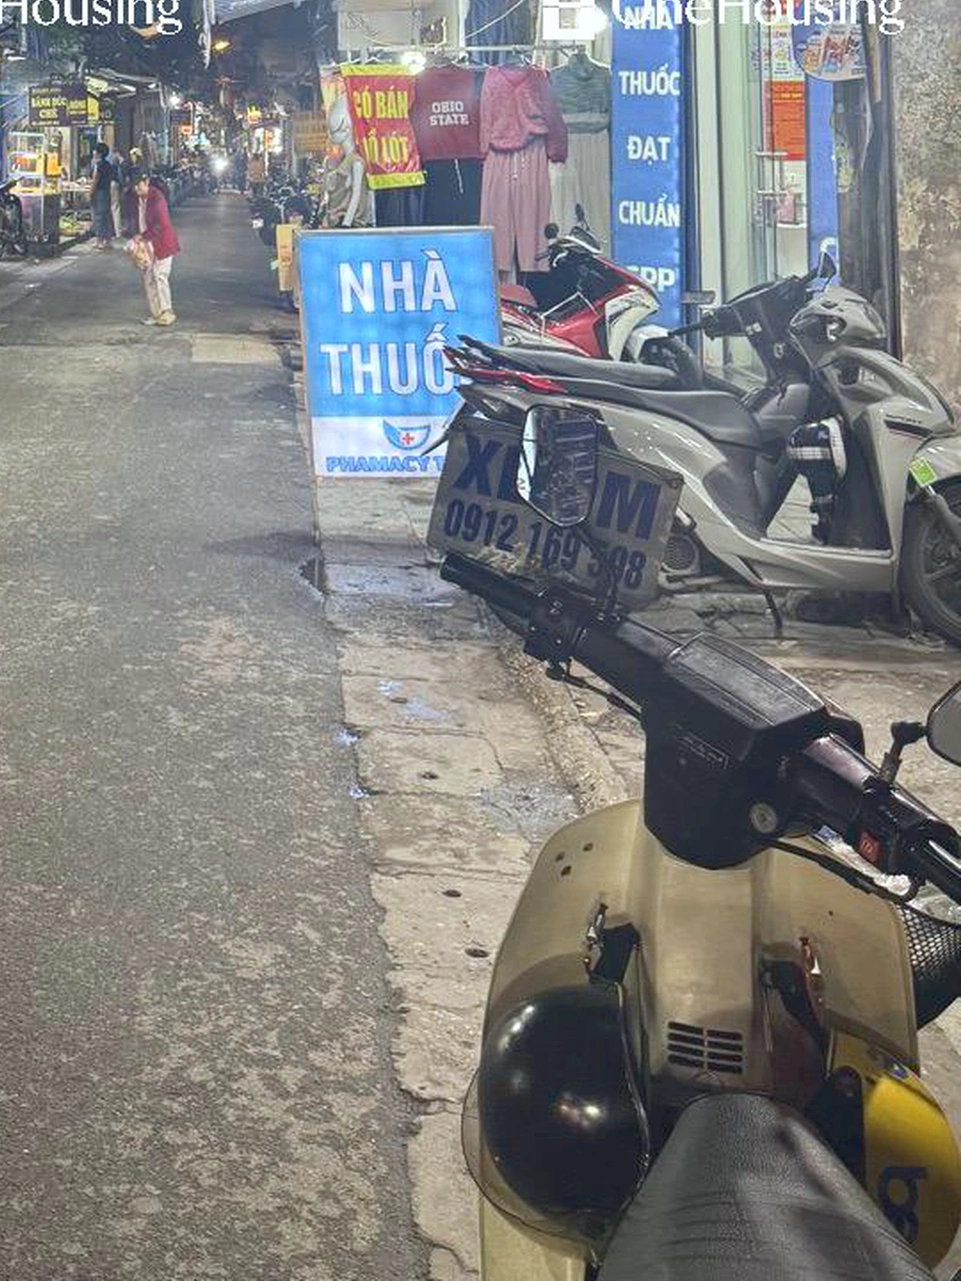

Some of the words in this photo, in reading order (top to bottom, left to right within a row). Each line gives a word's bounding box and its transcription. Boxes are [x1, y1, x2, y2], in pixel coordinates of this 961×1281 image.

[619, 63, 681, 96] THUỐC
[376, 84, 409, 119] BÁN
[431, 100, 464, 113] OHIO
[430, 113, 470, 126] STATE
[627, 135, 671, 165] ĐẠT
[619, 192, 681, 228] CHUẨN
[339, 248, 459, 314] NHÀ
[627, 266, 677, 292] PP
[320, 322, 455, 397] THUỐ
[326, 455, 430, 472] PHAMACY
[443, 498, 519, 552] 0912
